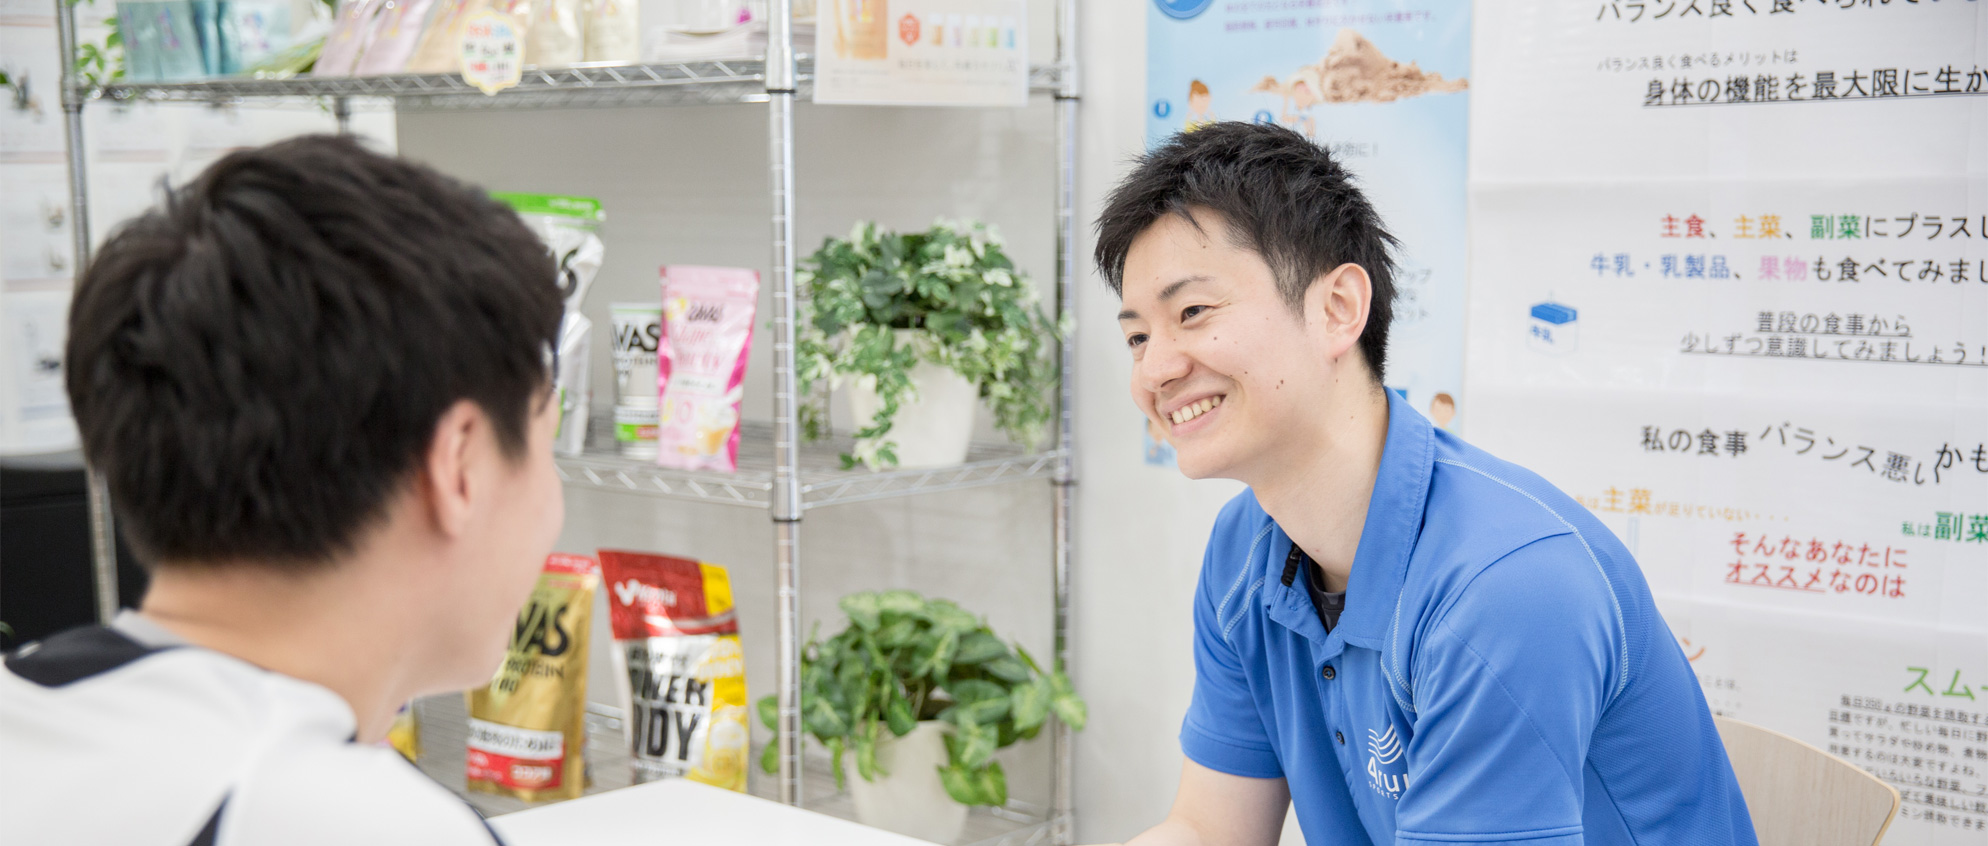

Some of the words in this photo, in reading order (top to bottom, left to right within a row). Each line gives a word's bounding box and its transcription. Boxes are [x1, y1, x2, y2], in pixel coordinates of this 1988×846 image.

[1597, 49, 1798, 71] バランス良く食べるメリットは
[1644, 64, 1988, 106] 身体の機能を最大限に生か
[1661, 211, 1988, 240] 主食、主菜、副菜にプラスし
[1590, 252, 1988, 285] 牛乳・乳製品、果物も食べてみまし
[1757, 311, 1912, 337] 普段の食事から
[1902, 512, 1988, 542] 私は副菜
[1731, 532, 1908, 568] そんなあなたに
[1724, 560, 1906, 598] オススメなのは
[1904, 667, 1988, 700] スム
[1368, 780, 1399, 800] SPORTS
